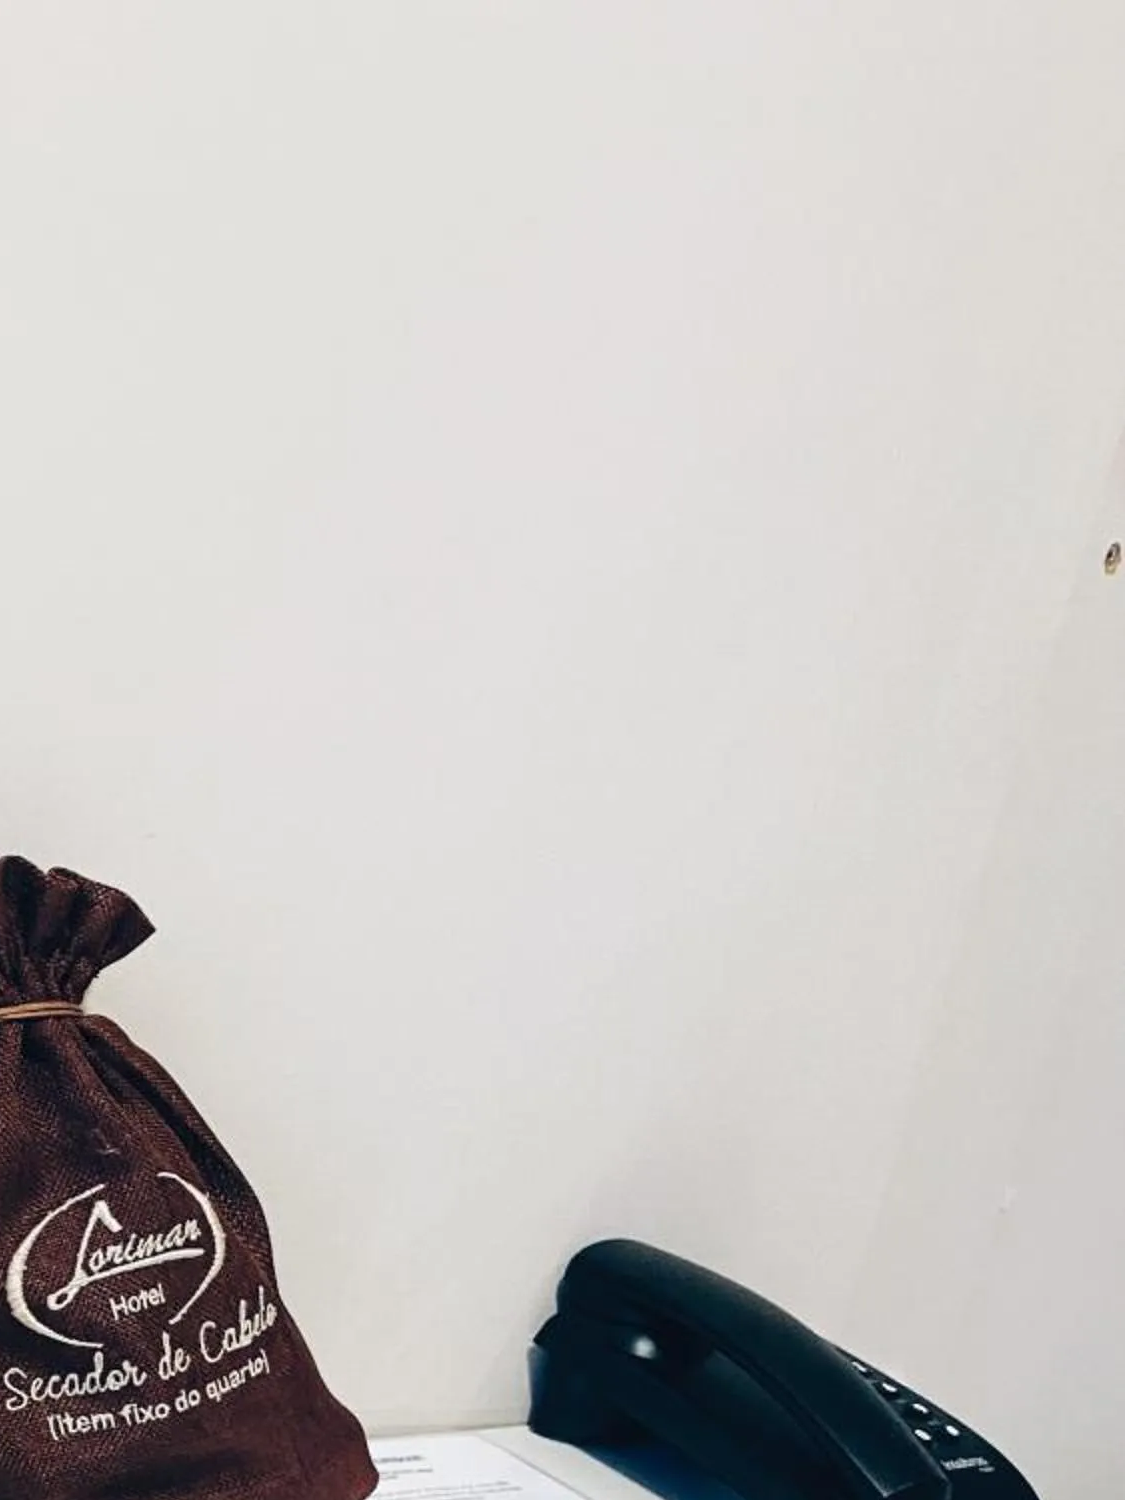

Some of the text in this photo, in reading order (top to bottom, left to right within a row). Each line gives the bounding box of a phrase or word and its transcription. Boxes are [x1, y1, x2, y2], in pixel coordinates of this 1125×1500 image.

[3, 1285, 277, 1411] Secador de Cabelo
[108, 1283, 166, 1321] Hotel
[47, 1348, 271, 1441] (Item fixo do quarto)
